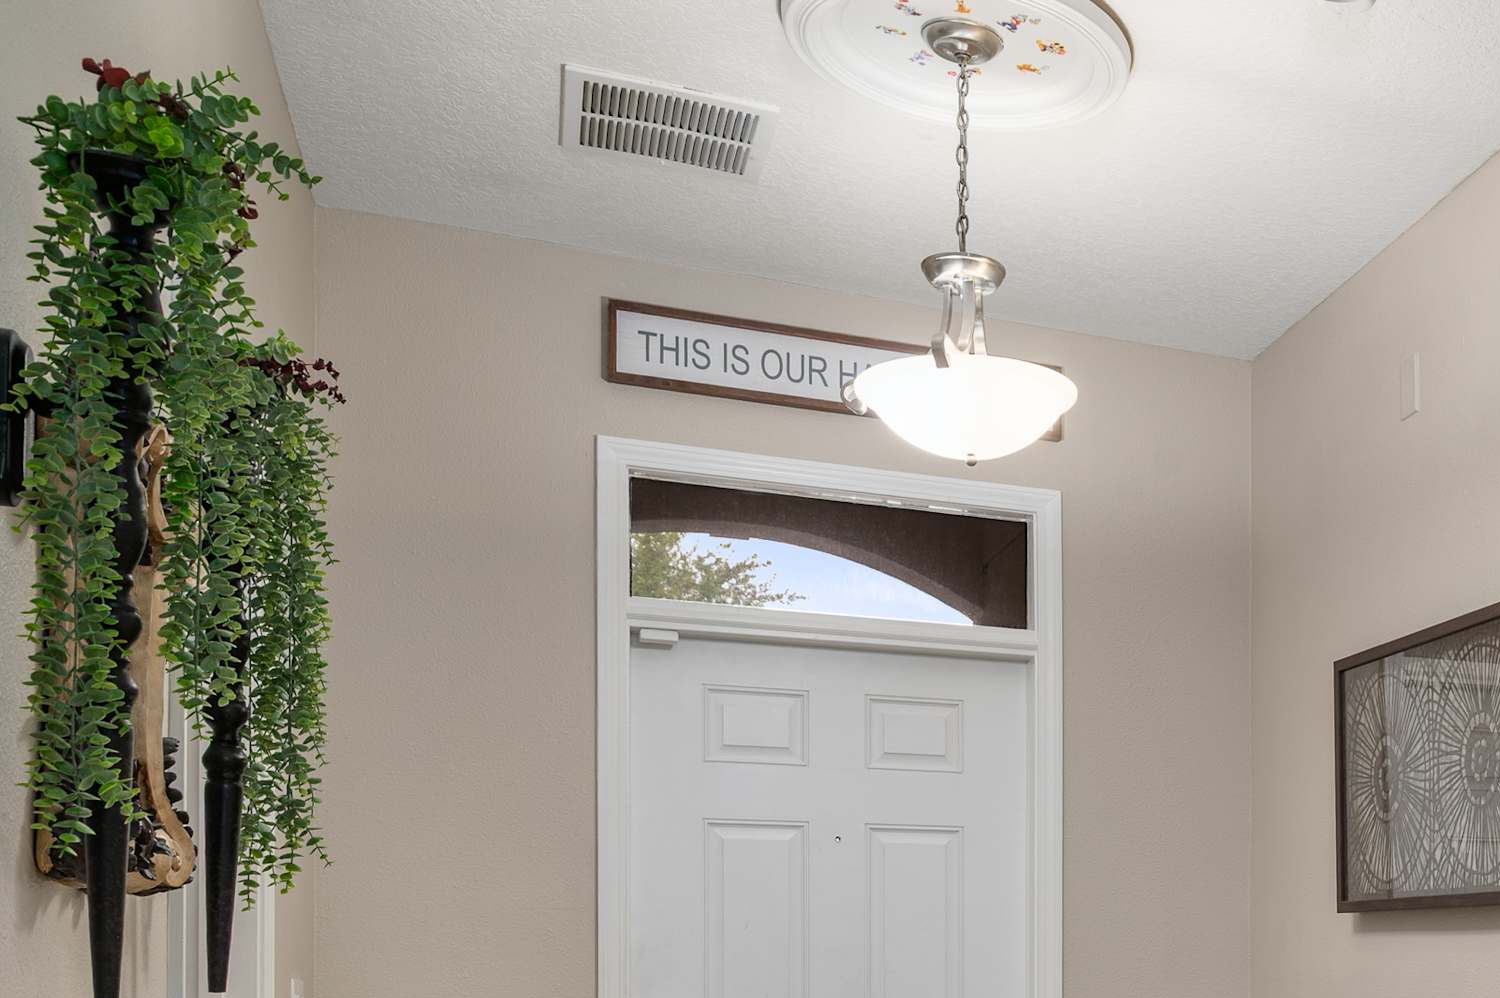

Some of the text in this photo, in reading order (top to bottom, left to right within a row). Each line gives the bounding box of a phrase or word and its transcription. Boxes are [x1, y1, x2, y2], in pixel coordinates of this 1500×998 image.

[637, 330, 711, 370] THIS
[723, 342, 750, 376] IS
[760, 349, 829, 387] OUR
